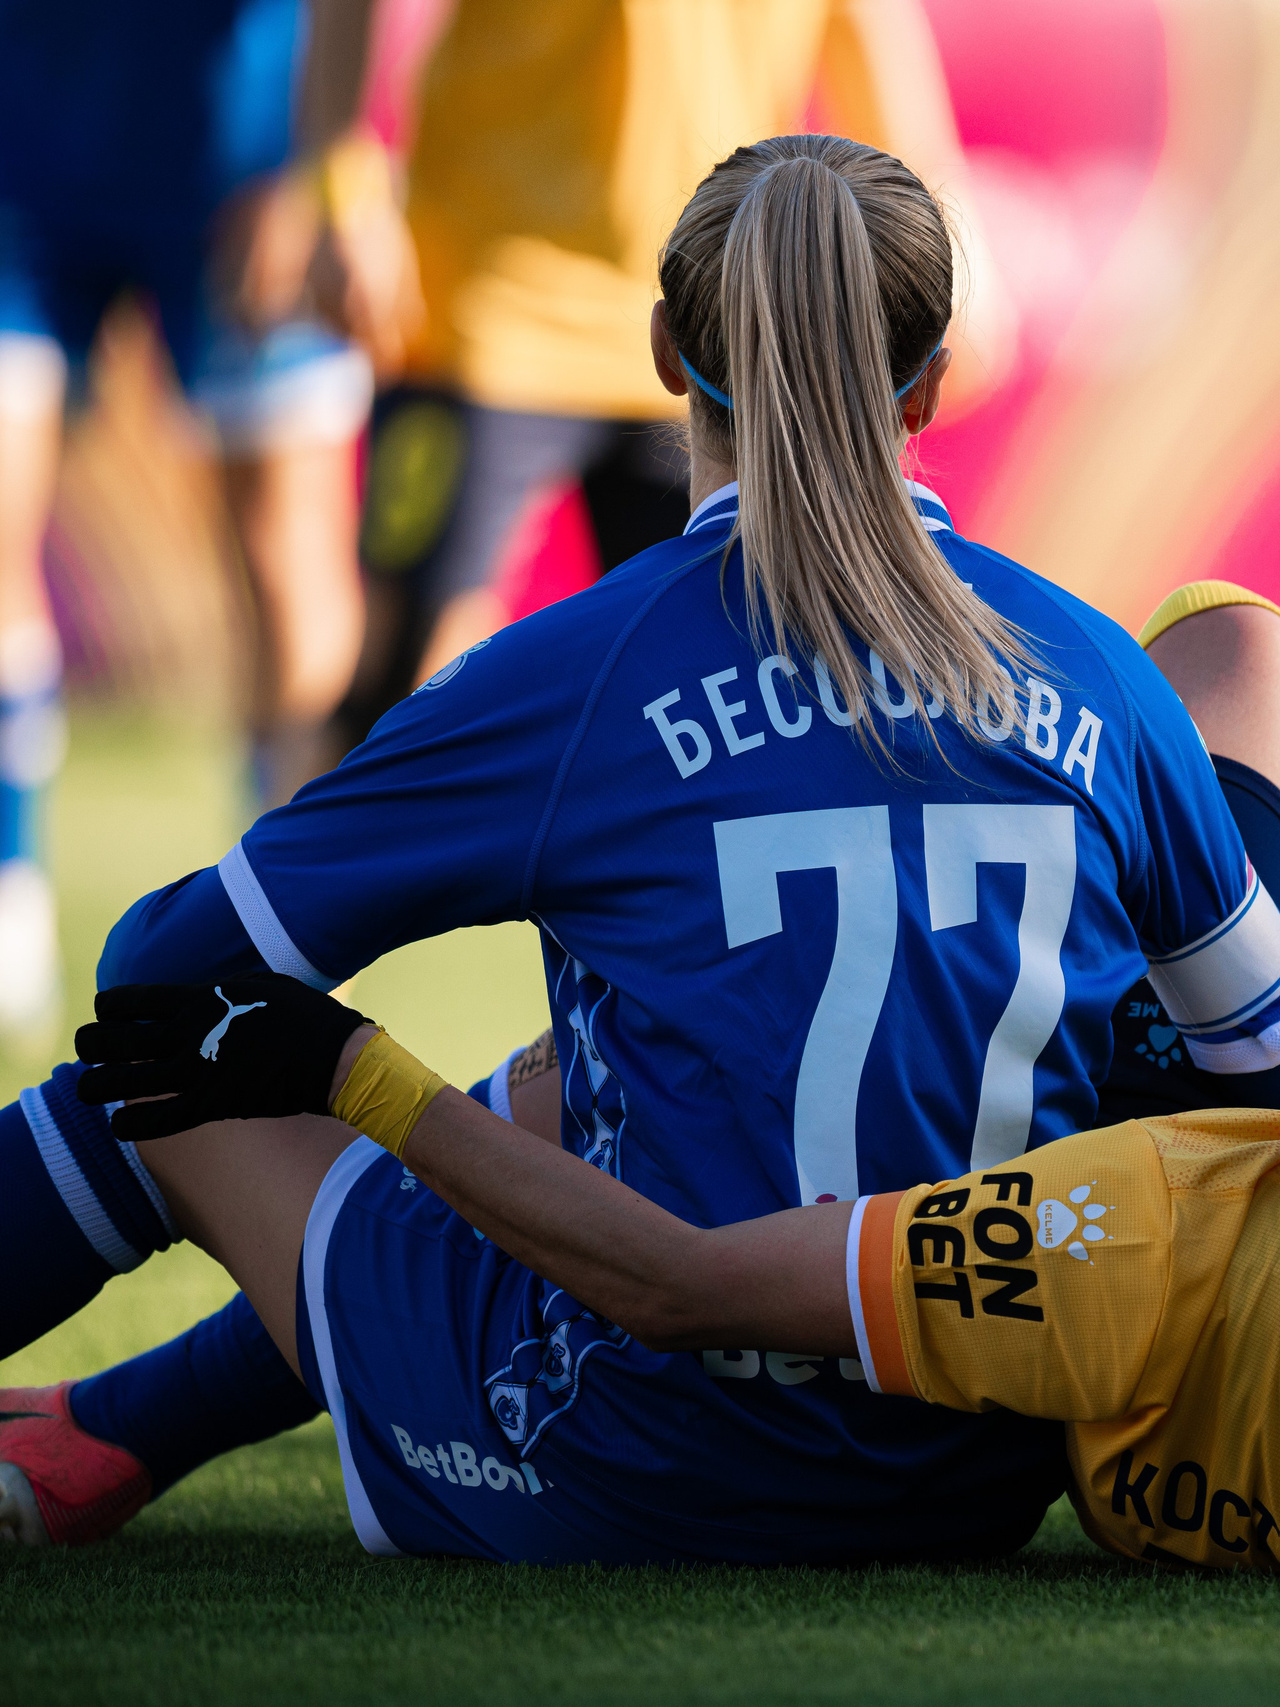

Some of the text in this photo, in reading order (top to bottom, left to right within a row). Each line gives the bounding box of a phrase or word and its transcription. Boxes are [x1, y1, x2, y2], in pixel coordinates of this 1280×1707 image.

[712, 803, 1077, 1207] 77
[907, 1187, 975, 1320] BET
[972, 1171, 1045, 1323] FON
[1044, 1204, 1053, 1245] KELME
